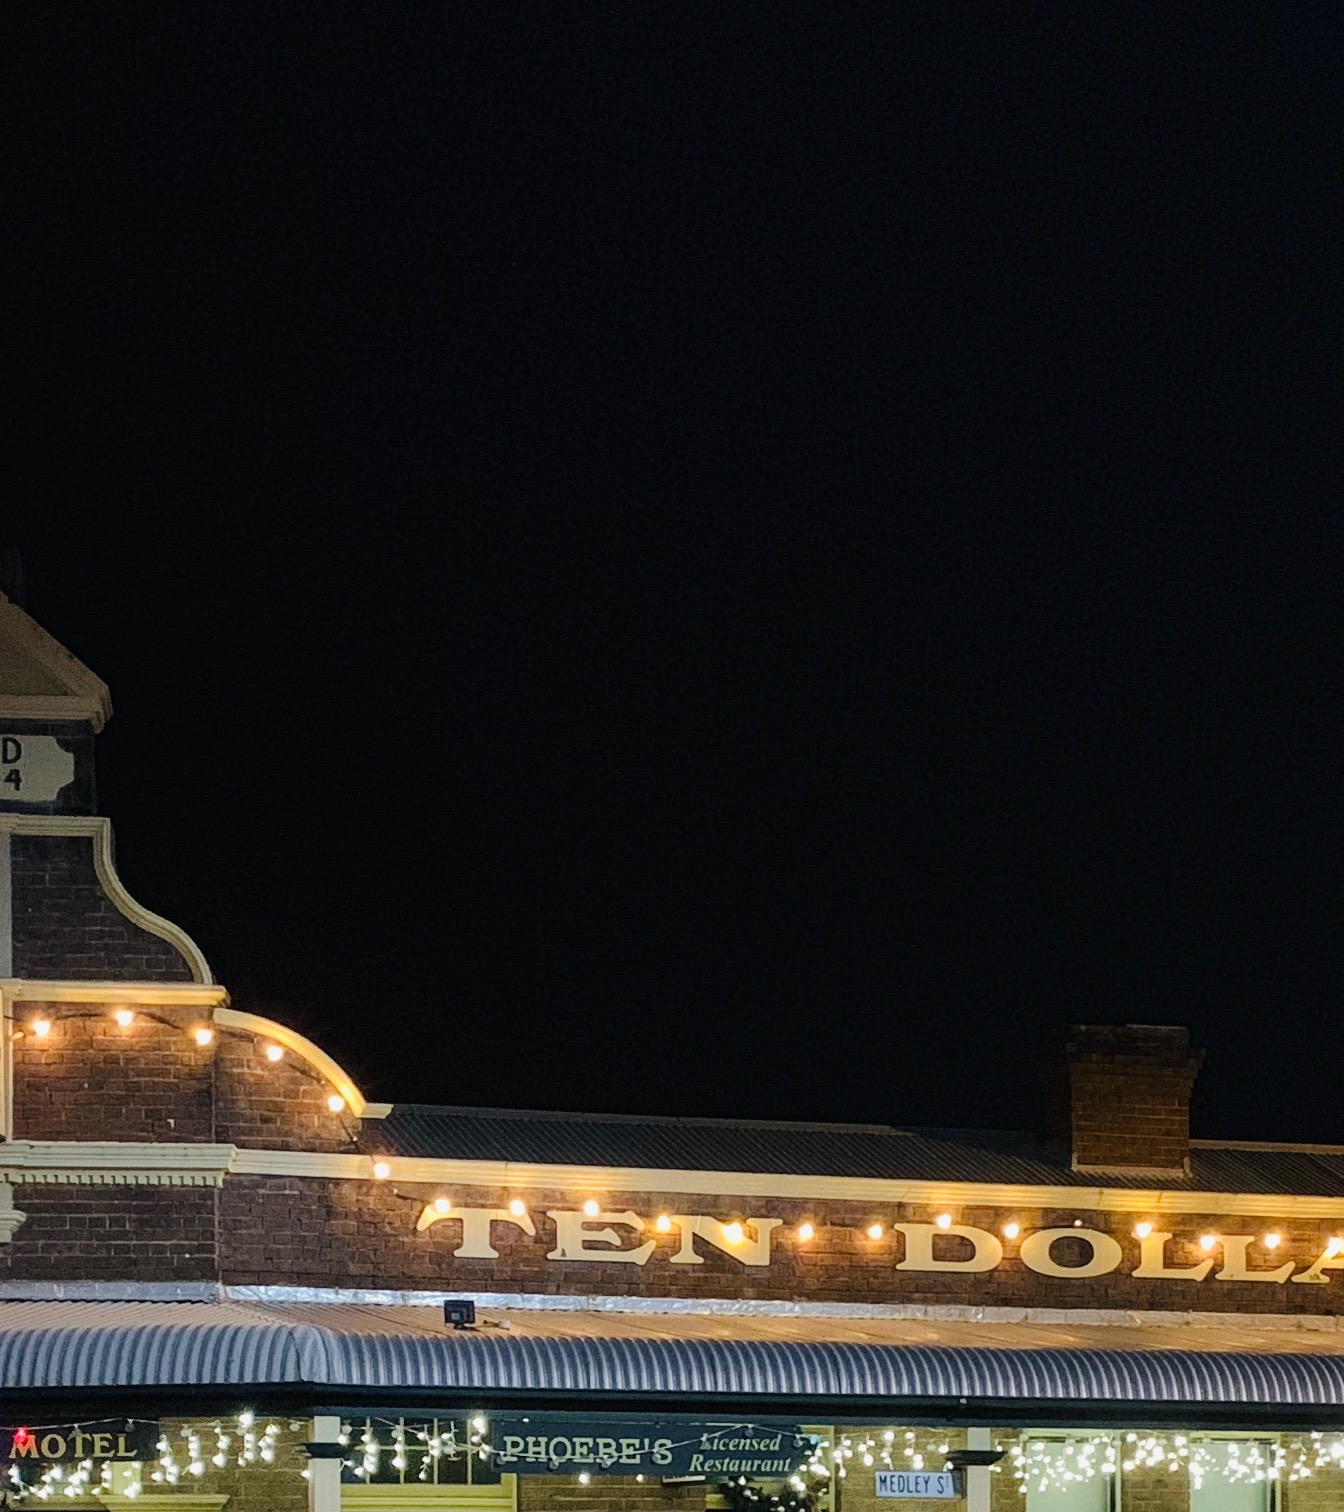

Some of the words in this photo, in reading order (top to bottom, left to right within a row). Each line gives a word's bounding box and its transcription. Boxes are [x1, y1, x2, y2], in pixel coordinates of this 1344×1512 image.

[416, 1204, 783, 1267] TEN
[8, 1432, 138, 1459] MOTEL
[502, 1435, 673, 1466] PHOEBE'S
[699, 1432, 782, 1452] Licensed
[688, 1453, 792, 1473] Restaurant
[879, 1474, 931, 1494] MEDLEY
